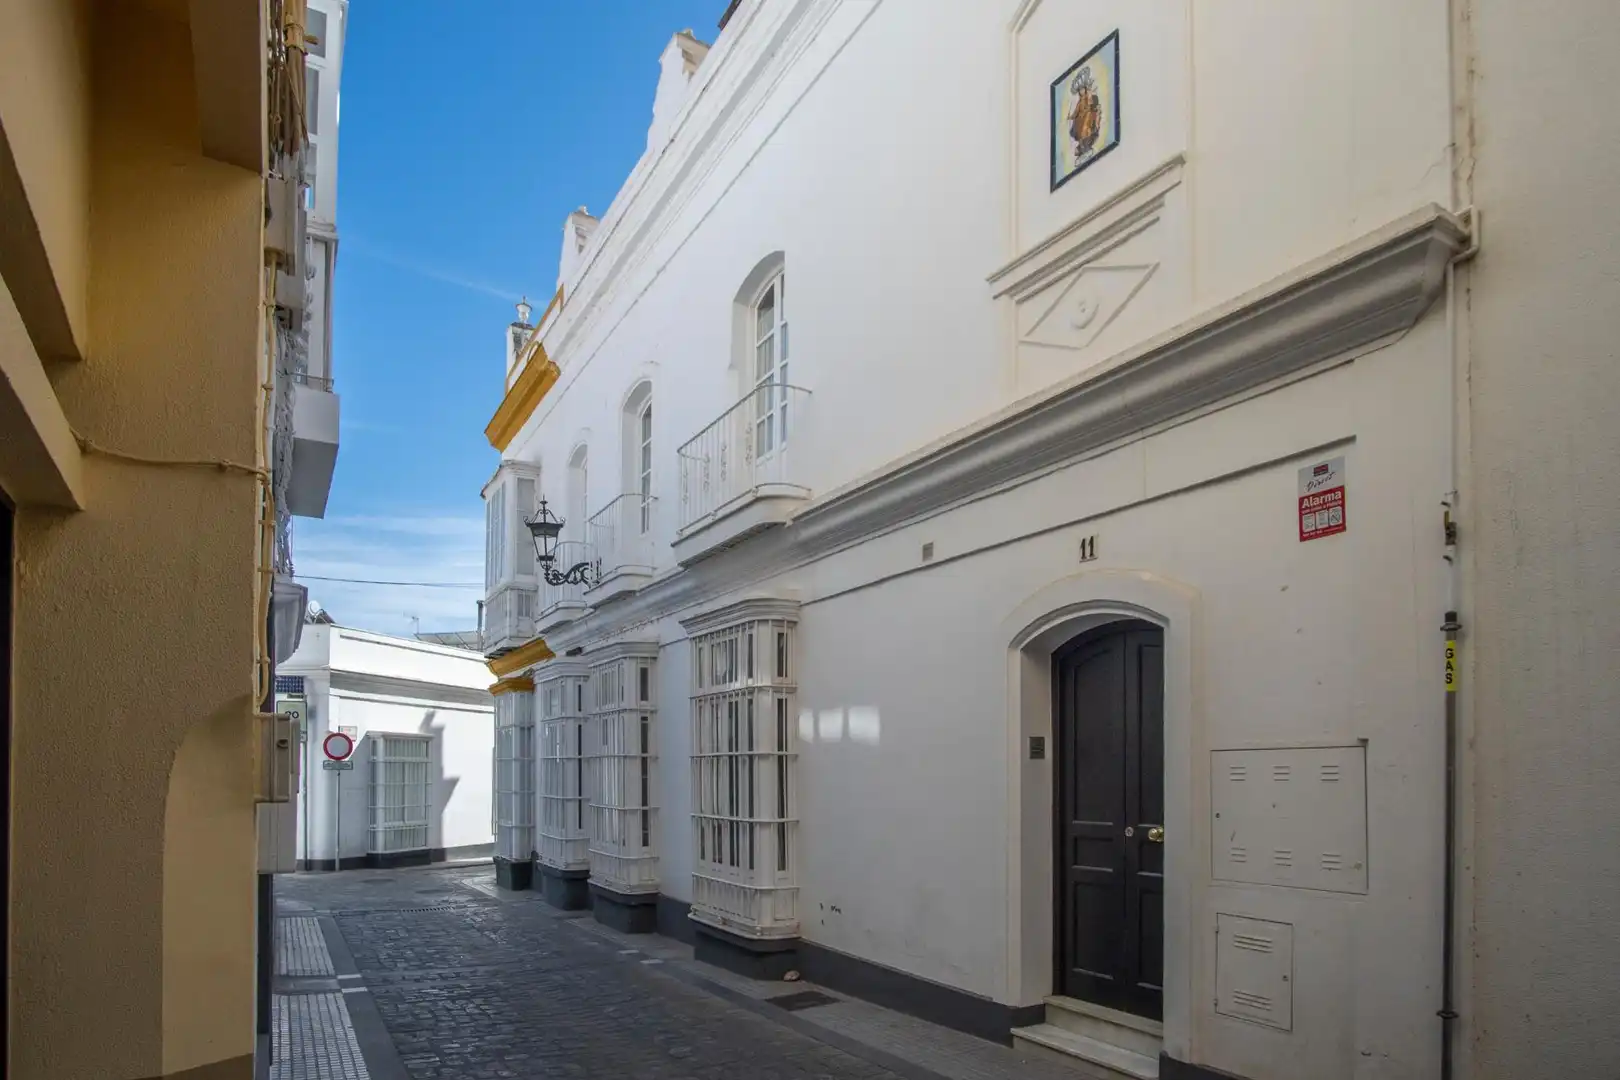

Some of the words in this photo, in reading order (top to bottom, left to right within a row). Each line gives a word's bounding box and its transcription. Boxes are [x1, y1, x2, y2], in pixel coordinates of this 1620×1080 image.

[1302, 490, 1342, 509] Alarma
[1079, 535, 1096, 560] 11
[1445, 648, 1454, 684] GAS
